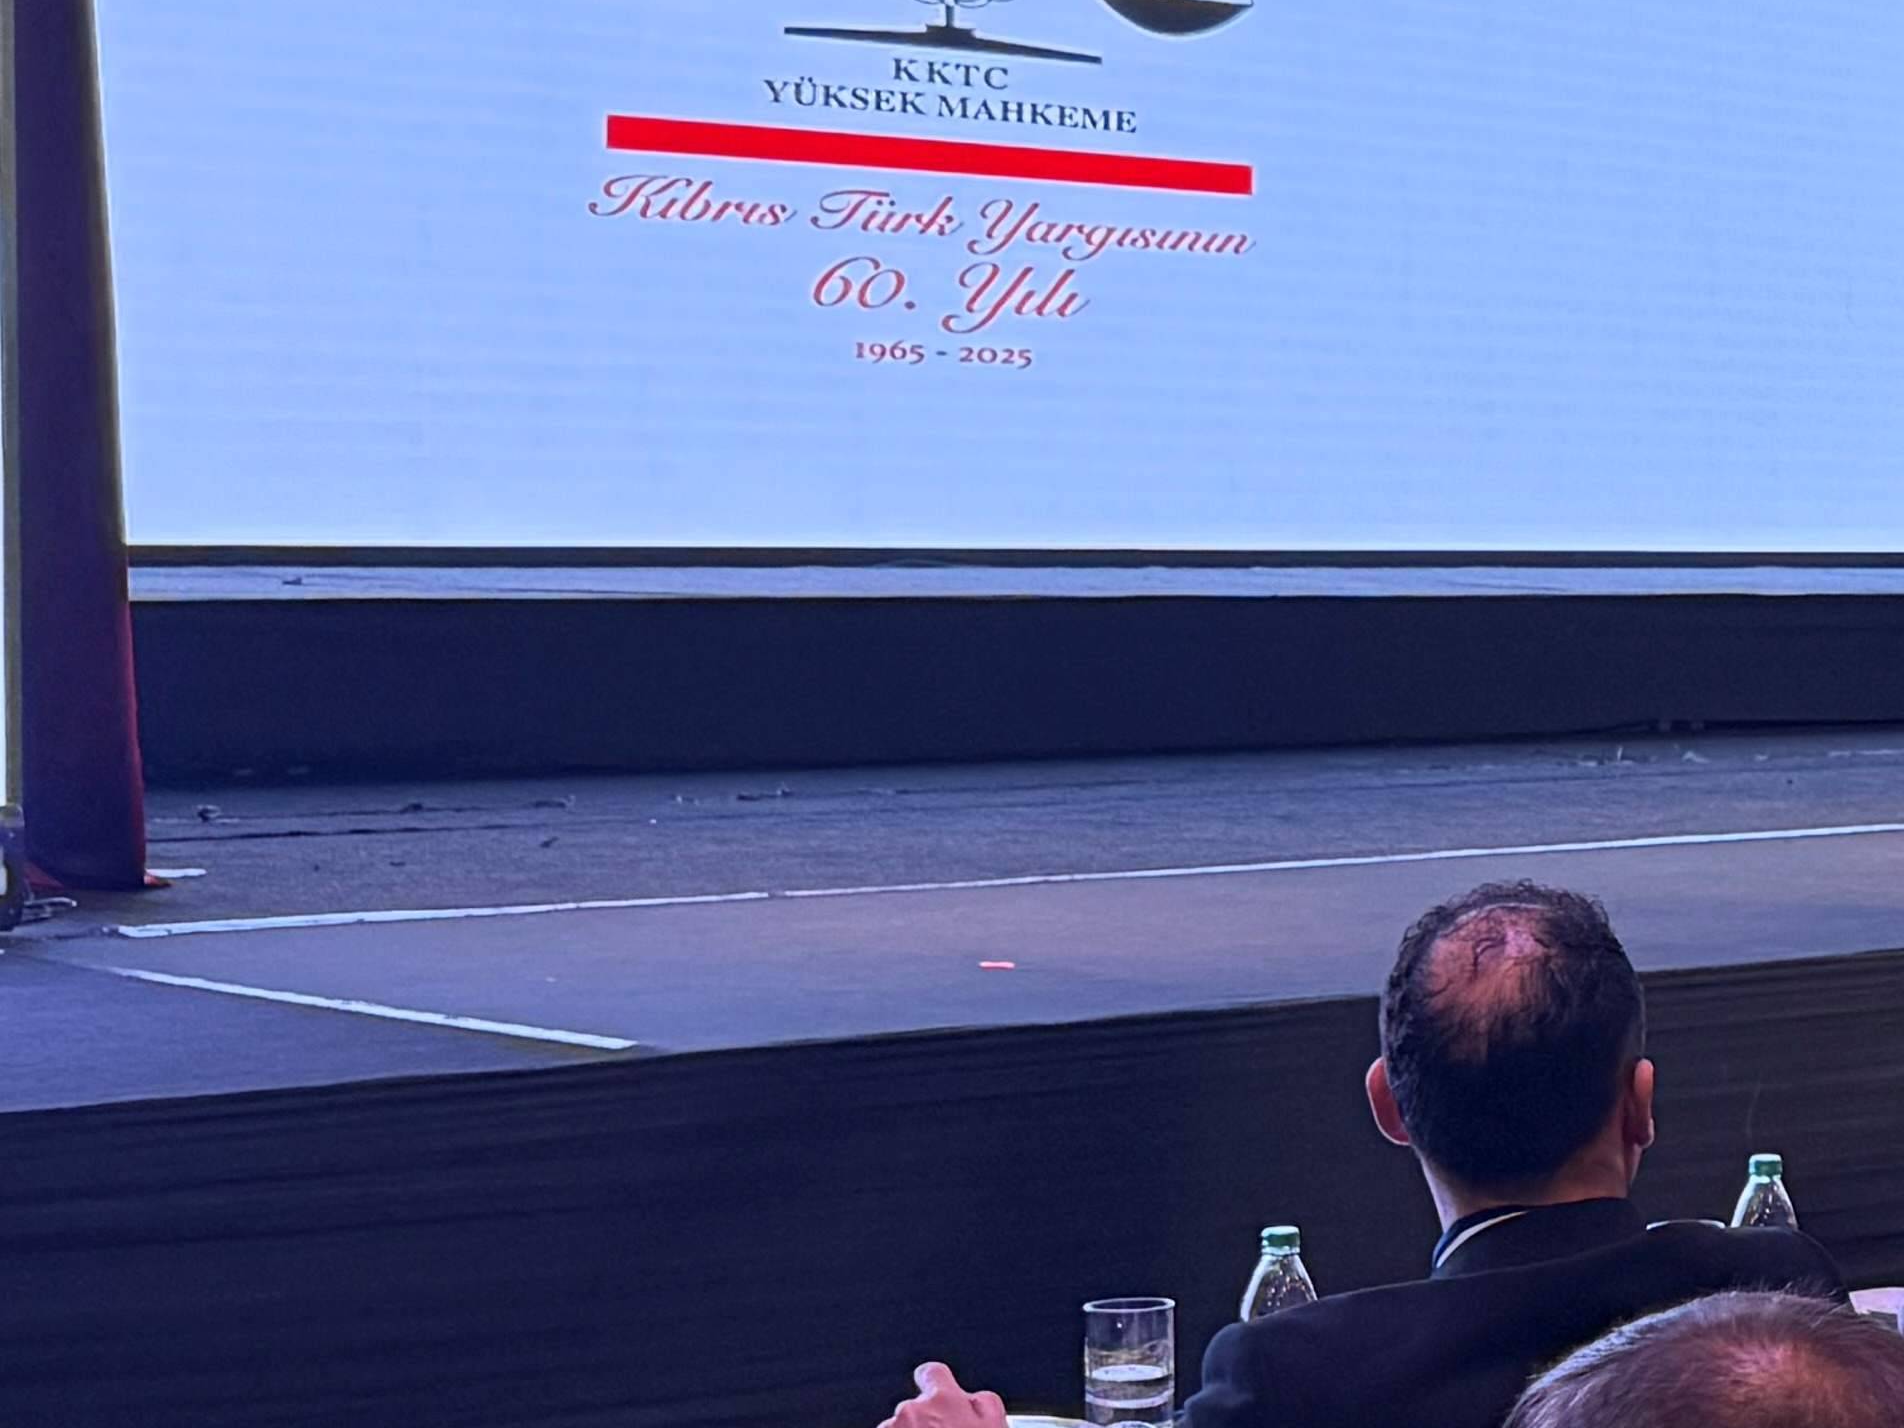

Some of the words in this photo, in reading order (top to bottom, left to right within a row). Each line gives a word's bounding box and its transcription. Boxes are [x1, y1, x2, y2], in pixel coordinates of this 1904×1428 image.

[892, 57, 1009, 90] KKTC
[763, 76, 927, 115] YÜKSEK
[937, 94, 1138, 134] MAHKEME
[588, 174, 796, 227] Kıbrıs
[810, 189, 963, 237] Türk
[966, 197, 1257, 261] Yargısının
[811, 256, 917, 310] 60.
[941, 262, 1090, 334] Yılı
[855, 340, 925, 366] 1965
[958, 343, 1033, 369] 2025
